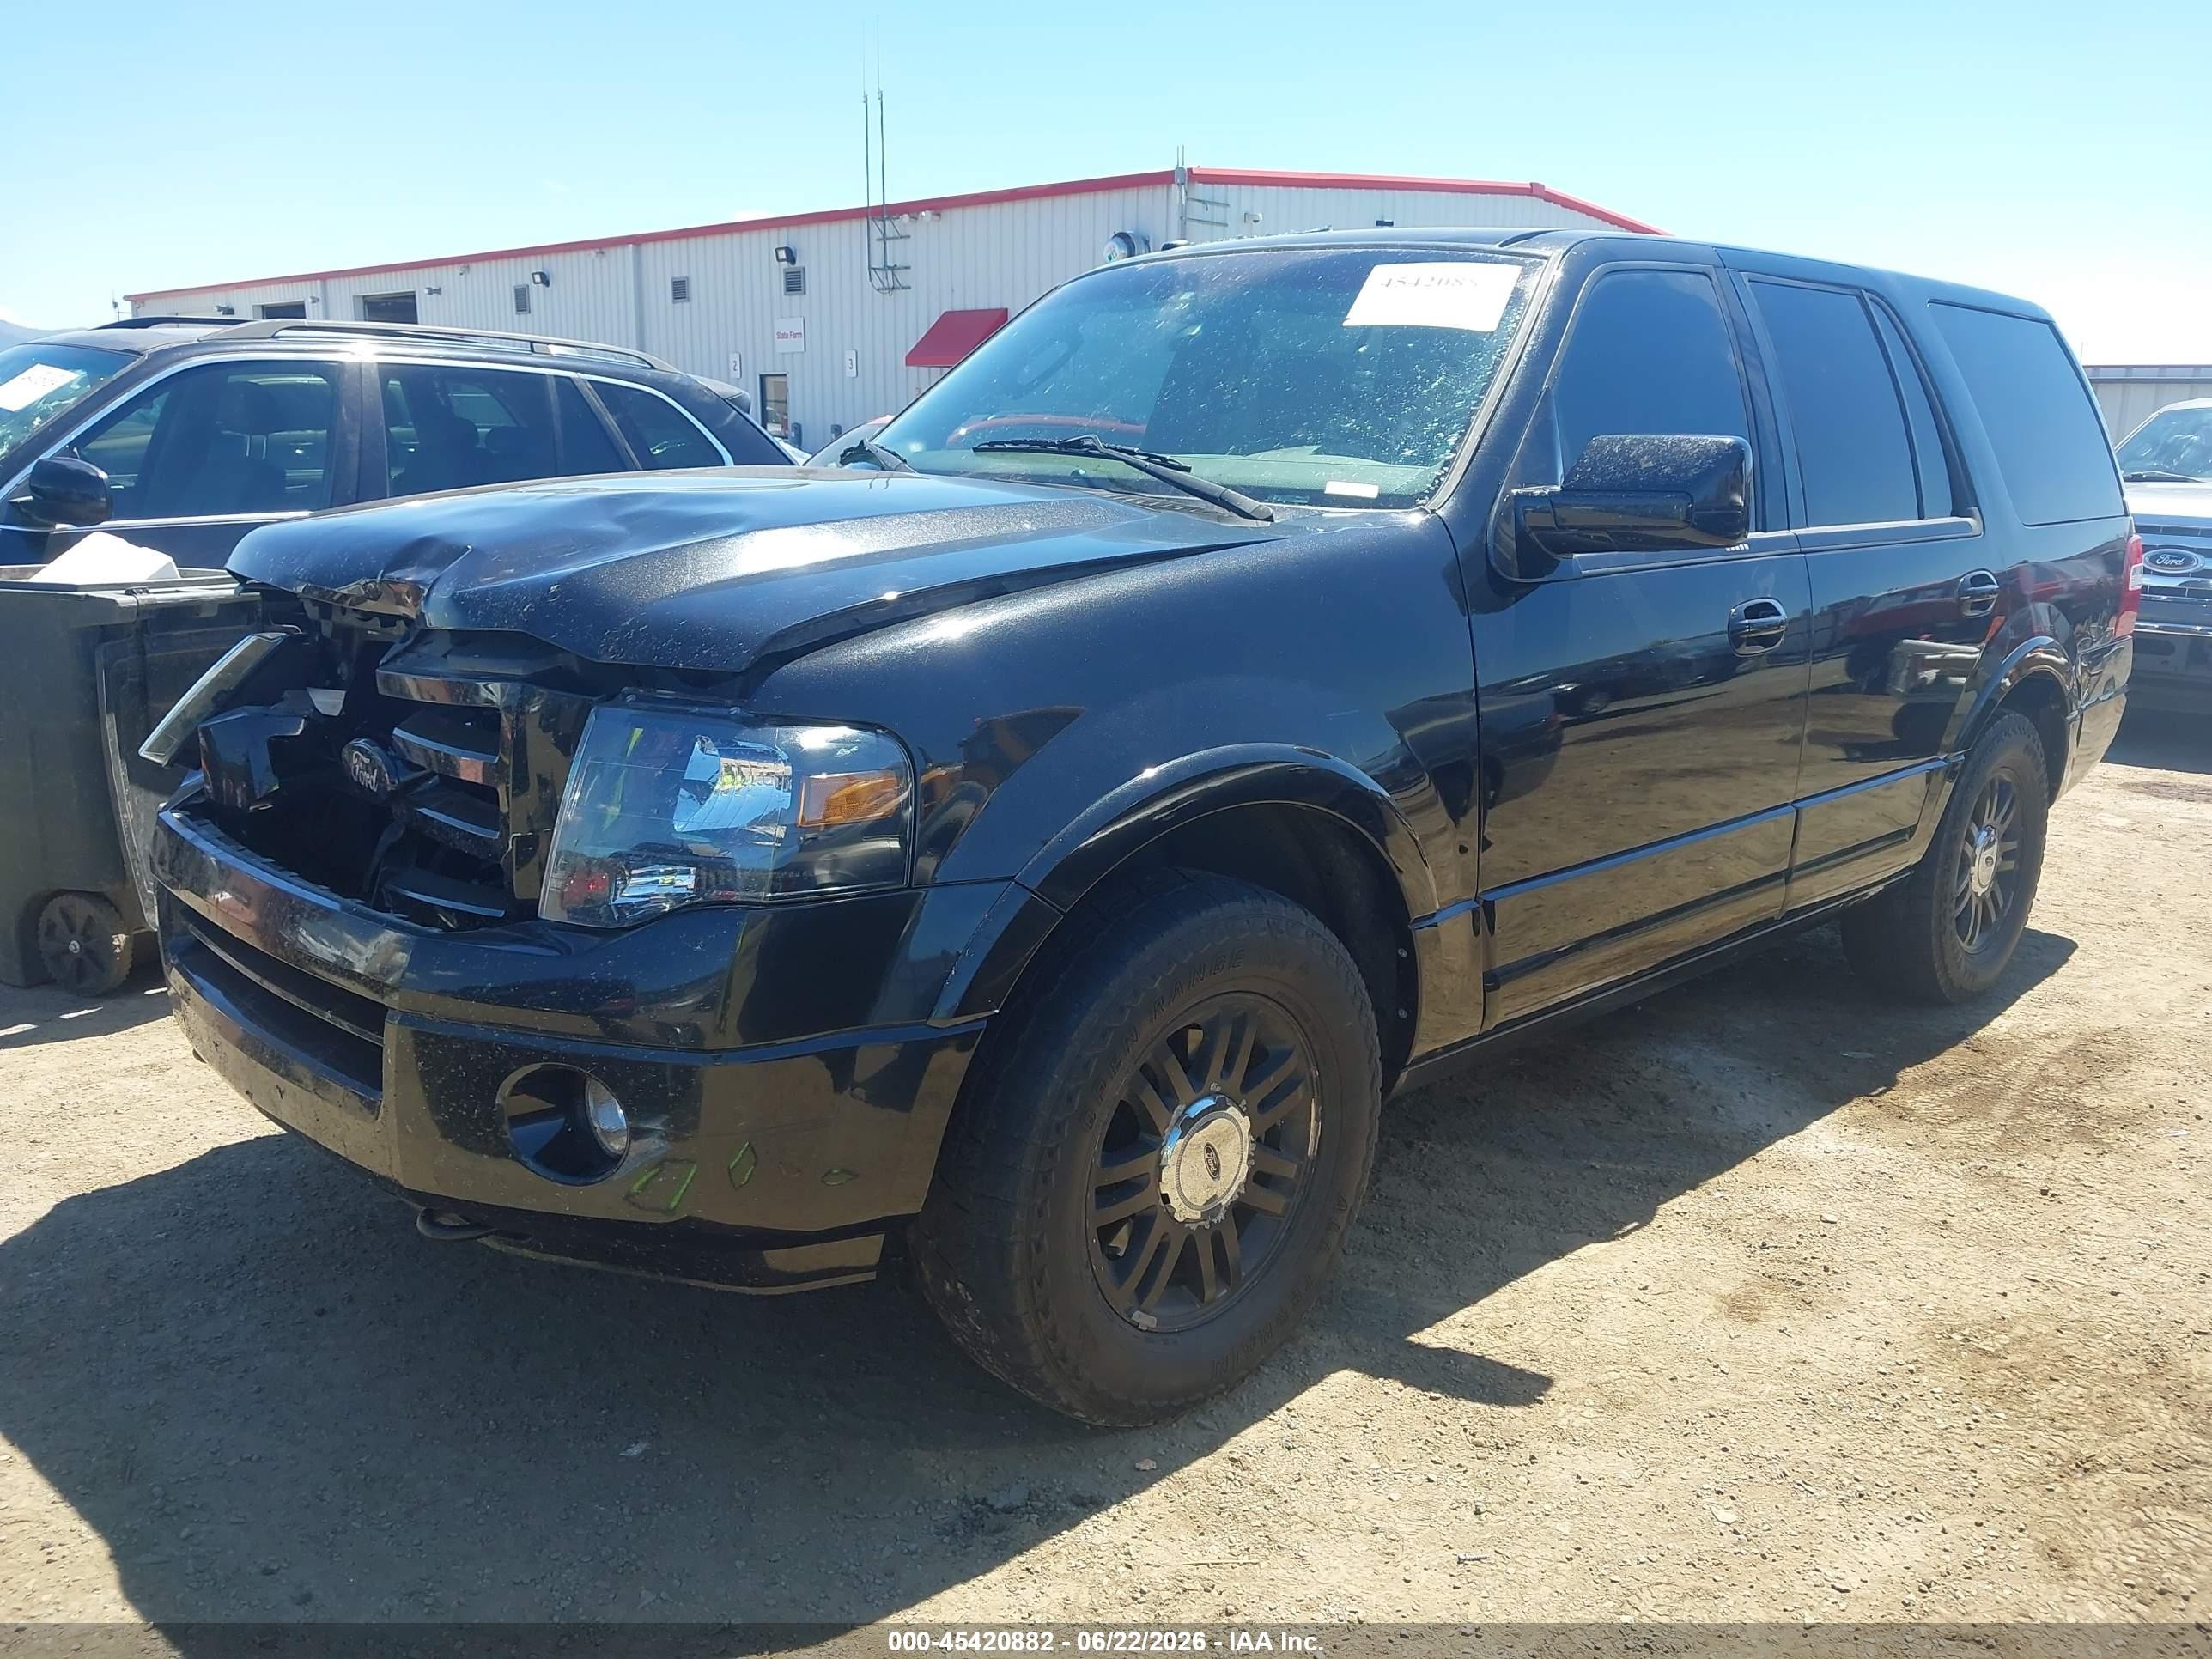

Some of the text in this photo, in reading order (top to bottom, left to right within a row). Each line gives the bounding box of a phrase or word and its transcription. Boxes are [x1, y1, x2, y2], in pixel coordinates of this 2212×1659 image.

[776, 331, 803, 340] State Farm
[2155, 553, 2185, 566] Ford
[350, 750, 379, 793] Ford
[1152, 947, 1246, 1021] RANGE
[1206, 1152, 1218, 1174] Ford
